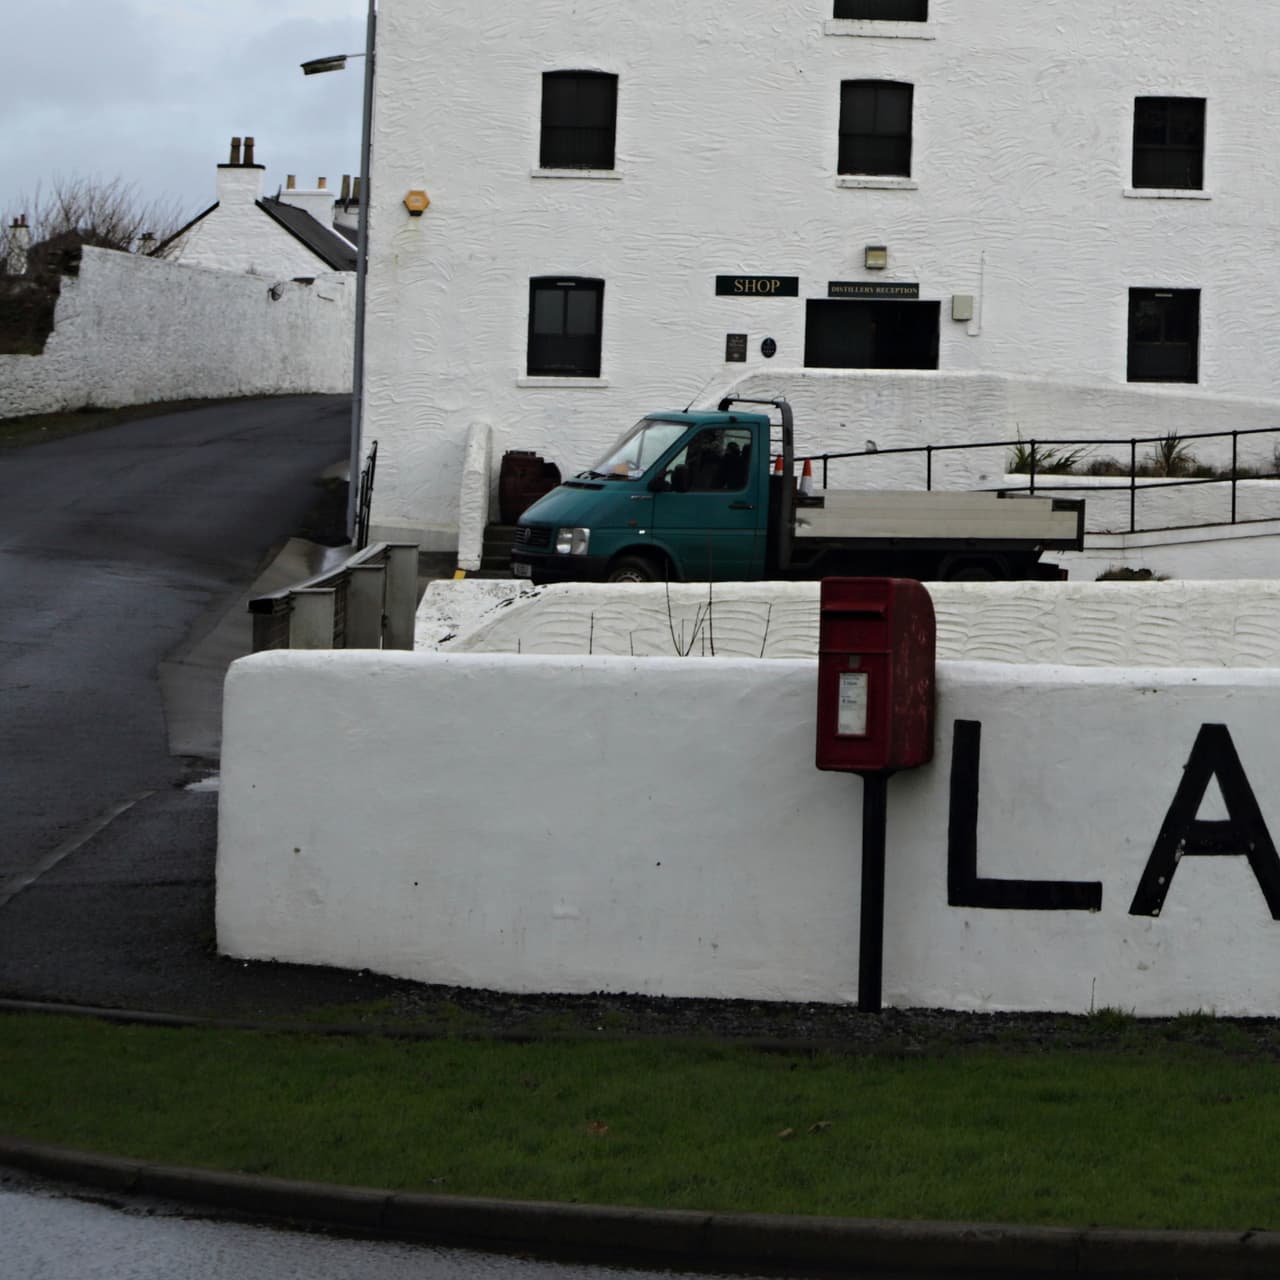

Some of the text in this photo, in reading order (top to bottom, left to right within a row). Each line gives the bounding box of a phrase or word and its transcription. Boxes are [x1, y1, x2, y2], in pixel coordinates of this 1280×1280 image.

[734, 279, 780, 293] SHOP
[832, 285, 918, 296] DISTILLERY RECEPTION
